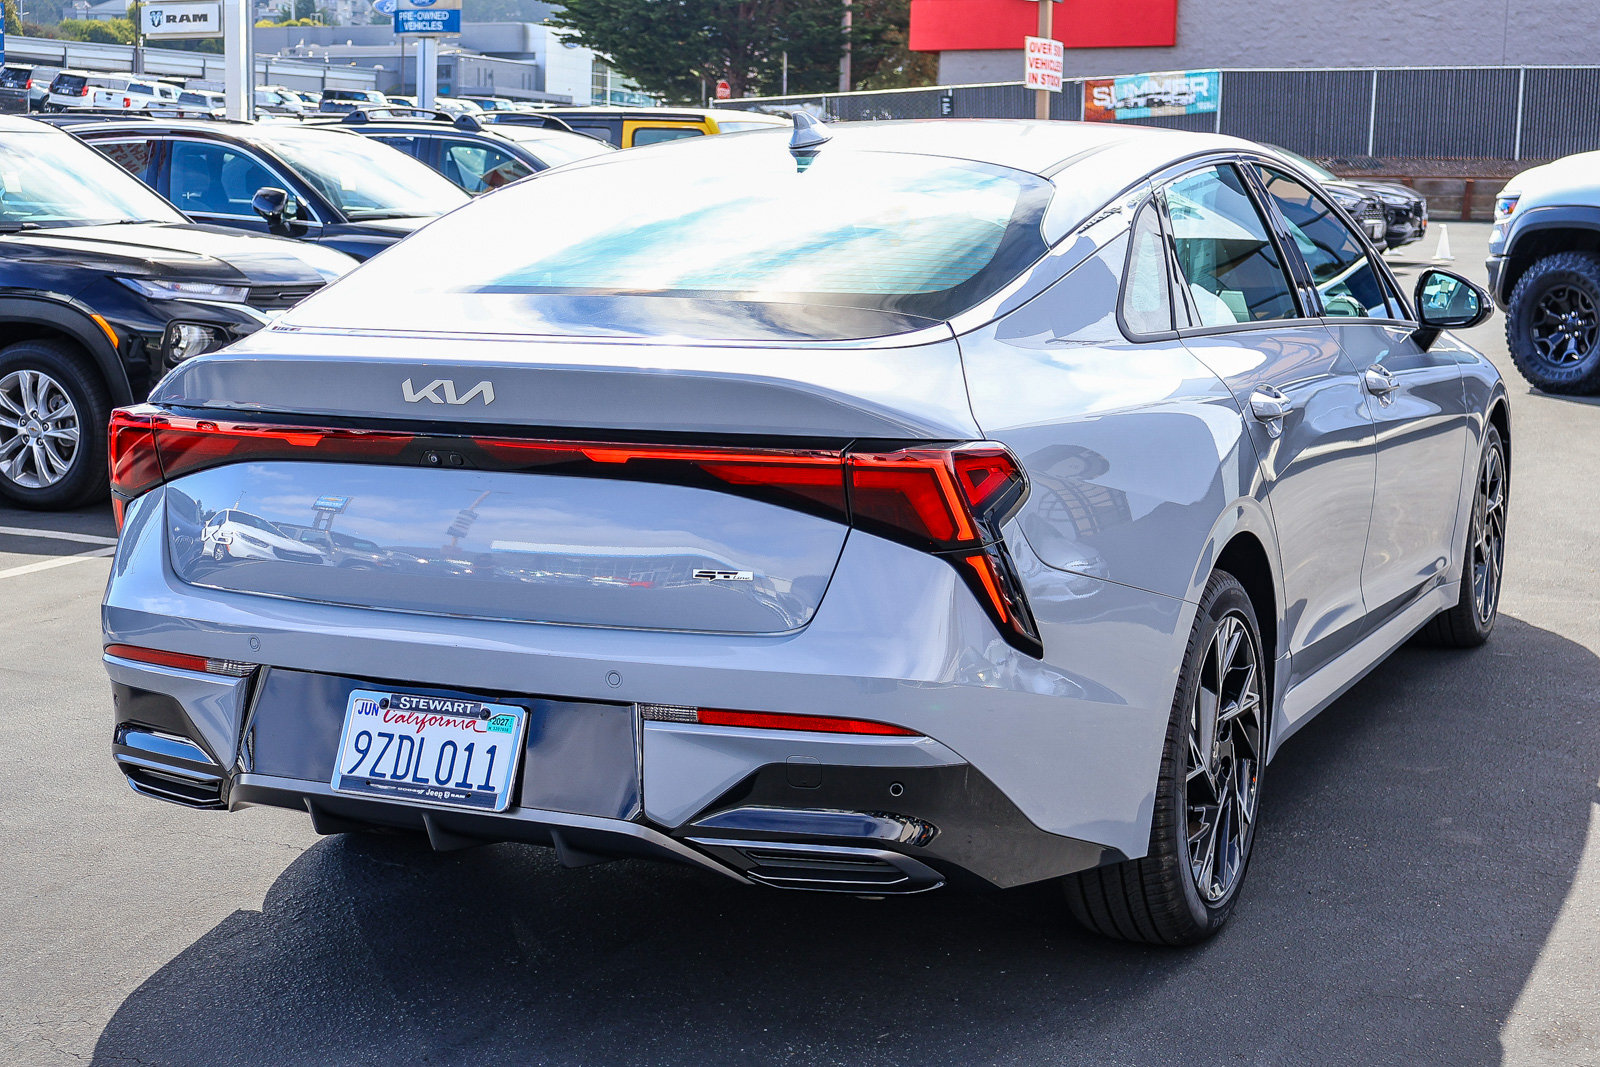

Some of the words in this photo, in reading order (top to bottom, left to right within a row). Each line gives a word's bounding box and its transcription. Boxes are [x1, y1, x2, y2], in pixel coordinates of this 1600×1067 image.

[166, 13, 208, 24] RAM
[398, 11, 449, 21] PRE-OWNED
[403, 21, 443, 31] VEHICLES
[1030, 41, 1052, 55] OVER
[1028, 72, 1039, 84] IN
[1093, 77, 1209, 107] SUMMER
[401, 378, 495, 406] KIA
[358, 702, 379, 717] JUN
[399, 696, 474, 713] STEWART
[383, 709, 488, 733] California
[491, 717, 509, 727] 2027
[347, 730, 498, 792] 9ZDL011
[425, 788, 443, 800] Jeep
